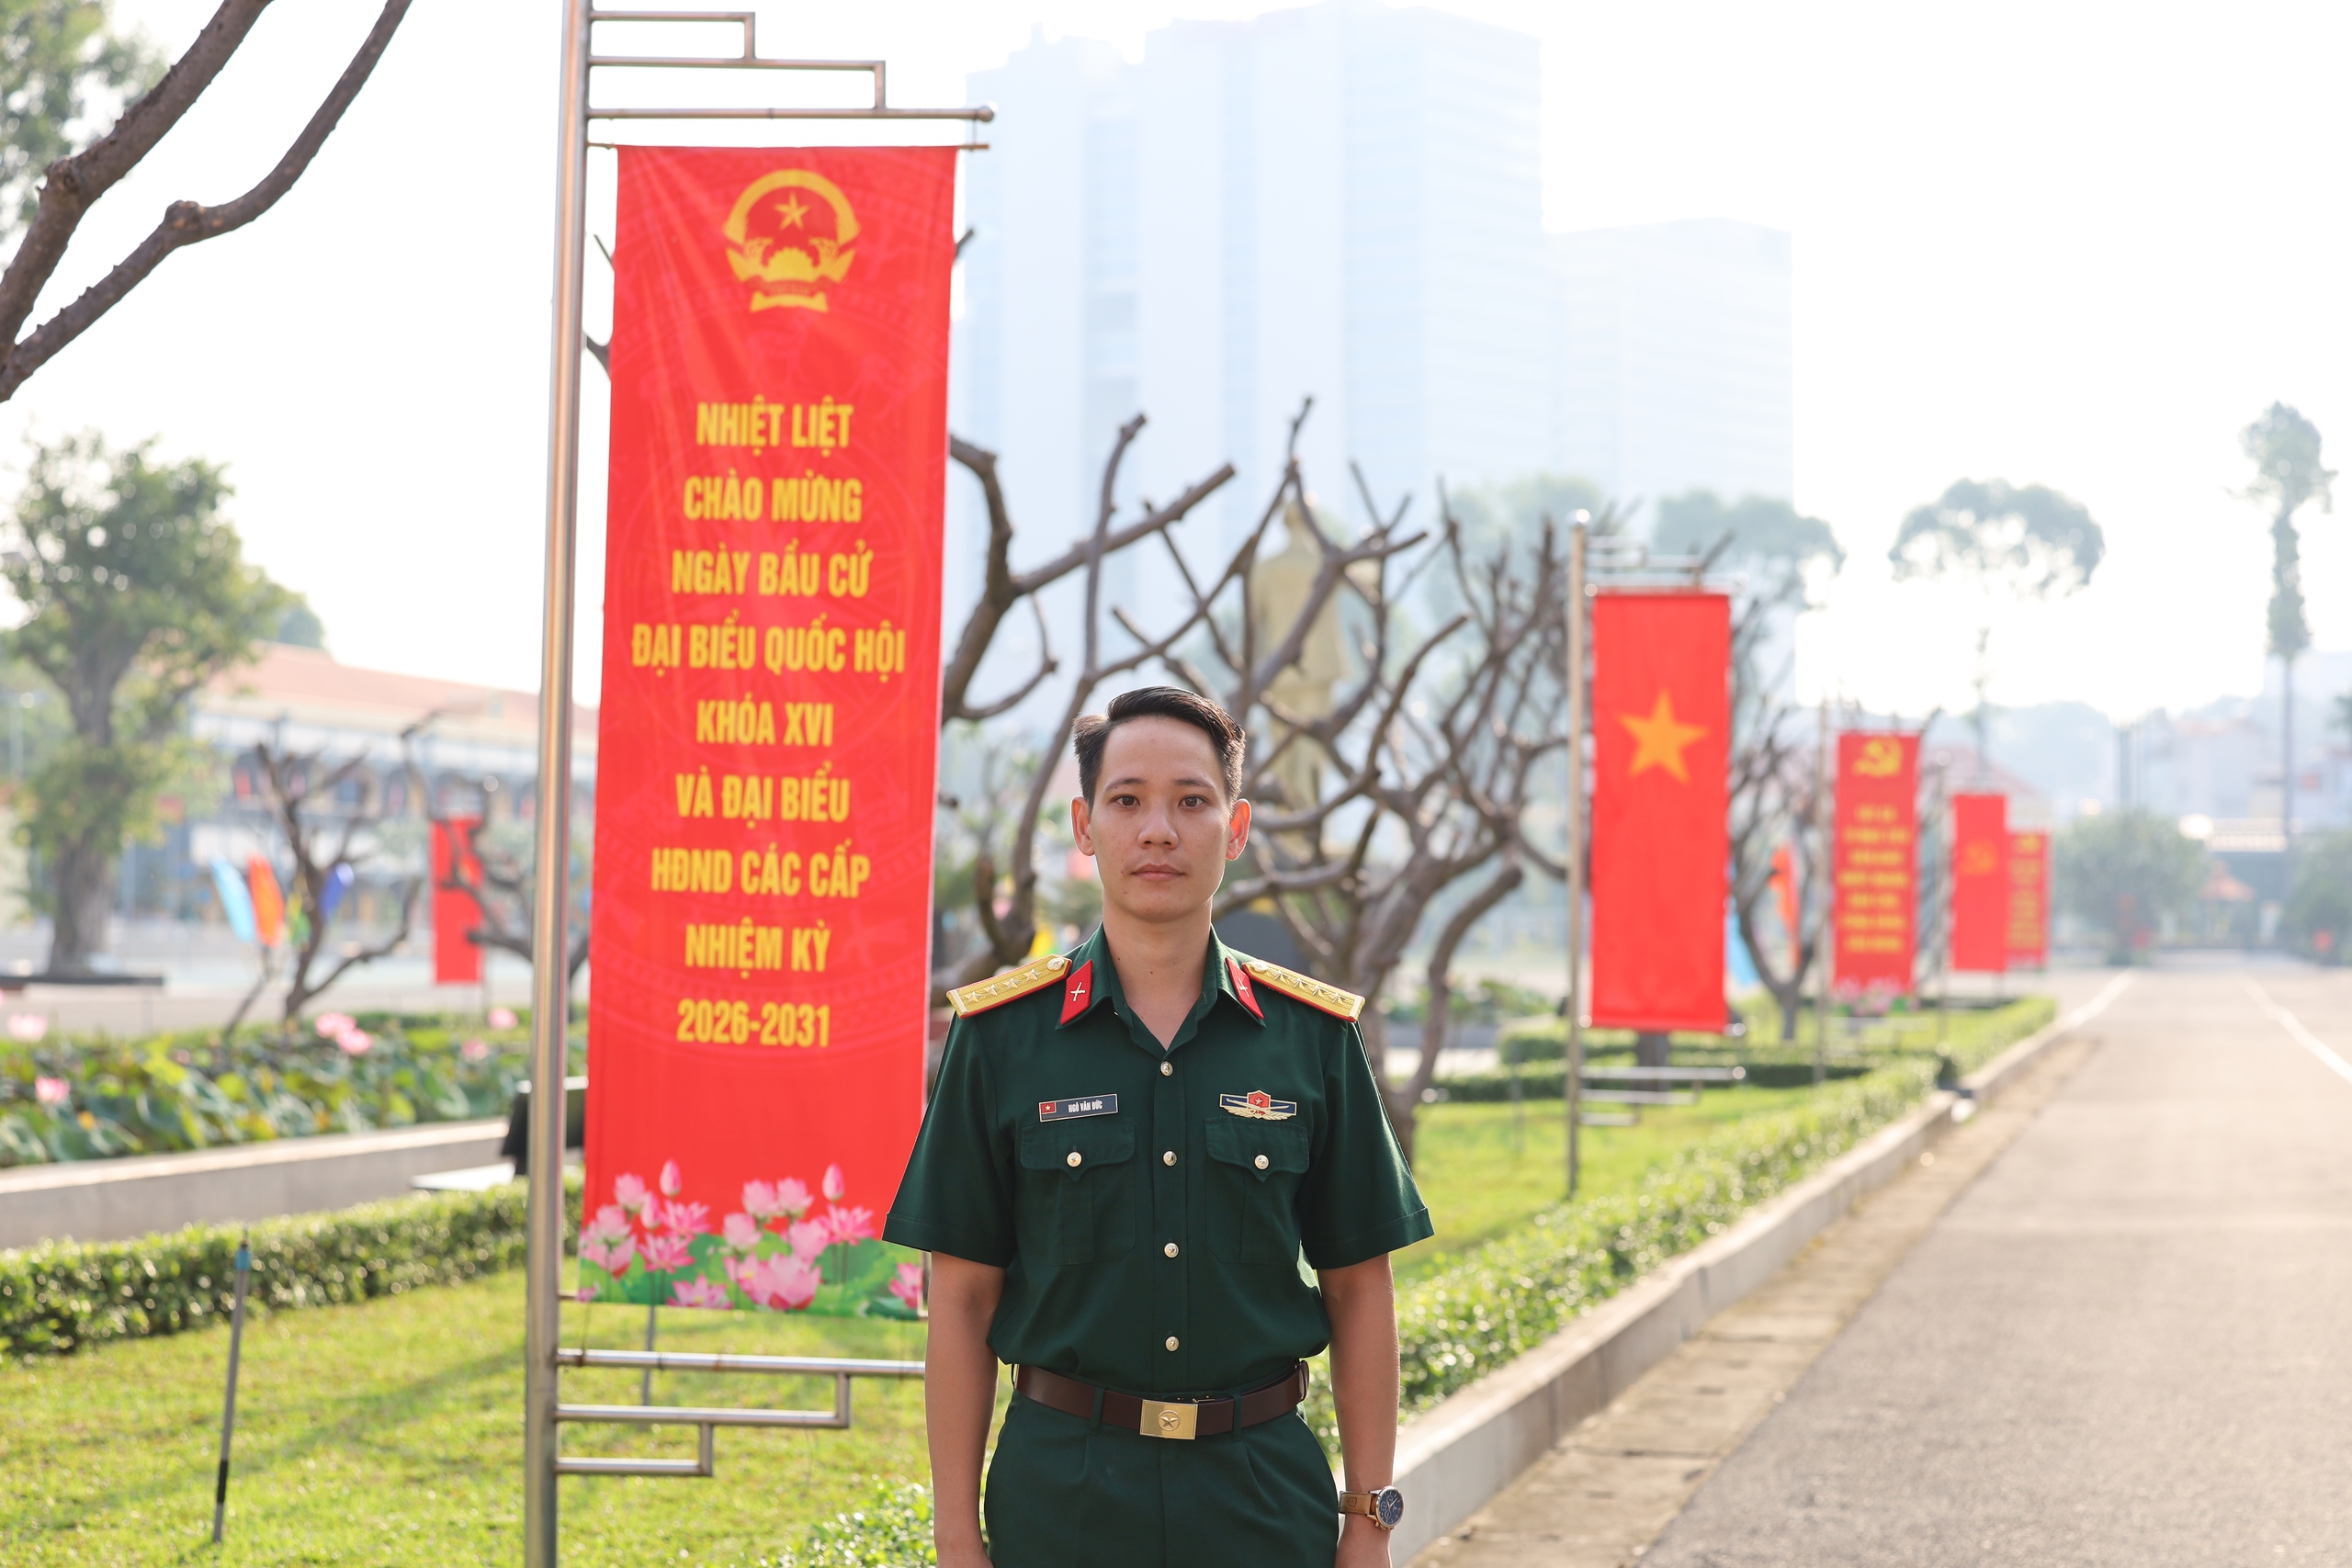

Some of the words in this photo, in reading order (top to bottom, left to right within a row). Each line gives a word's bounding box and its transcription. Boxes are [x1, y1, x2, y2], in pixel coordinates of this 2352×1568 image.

[695, 394, 786, 457] NHIỆT
[791, 395, 854, 457] LIỆT
[683, 468, 763, 522] CHÀO
[771, 468, 863, 523] MỪNG
[672, 542, 752, 594] NGÀY
[758, 538, 820, 597] BẦU
[828, 539, 874, 598] CỬ
[631, 623, 682, 677] ĐẠI
[688, 608, 757, 671] BIỂU
[763, 613, 847, 675] QUỐC
[854, 619, 906, 682] HỘI
[696, 692, 776, 745] KHÓA
[783, 702, 834, 747] XVI
[675, 765, 715, 818] VÀ
[721, 774, 774, 829] ĐẠI
[780, 761, 850, 823] BIỂU
[650, 847, 733, 894] HĐND
[740, 842, 802, 897] CÁC
[808, 839, 871, 898] CẤP
[684, 916, 784, 979] NHIỆM
[791, 919, 831, 972] KỲ
[676, 998, 831, 1047] 2026-2031
[1080, 1100, 1091, 1111] VĂN
